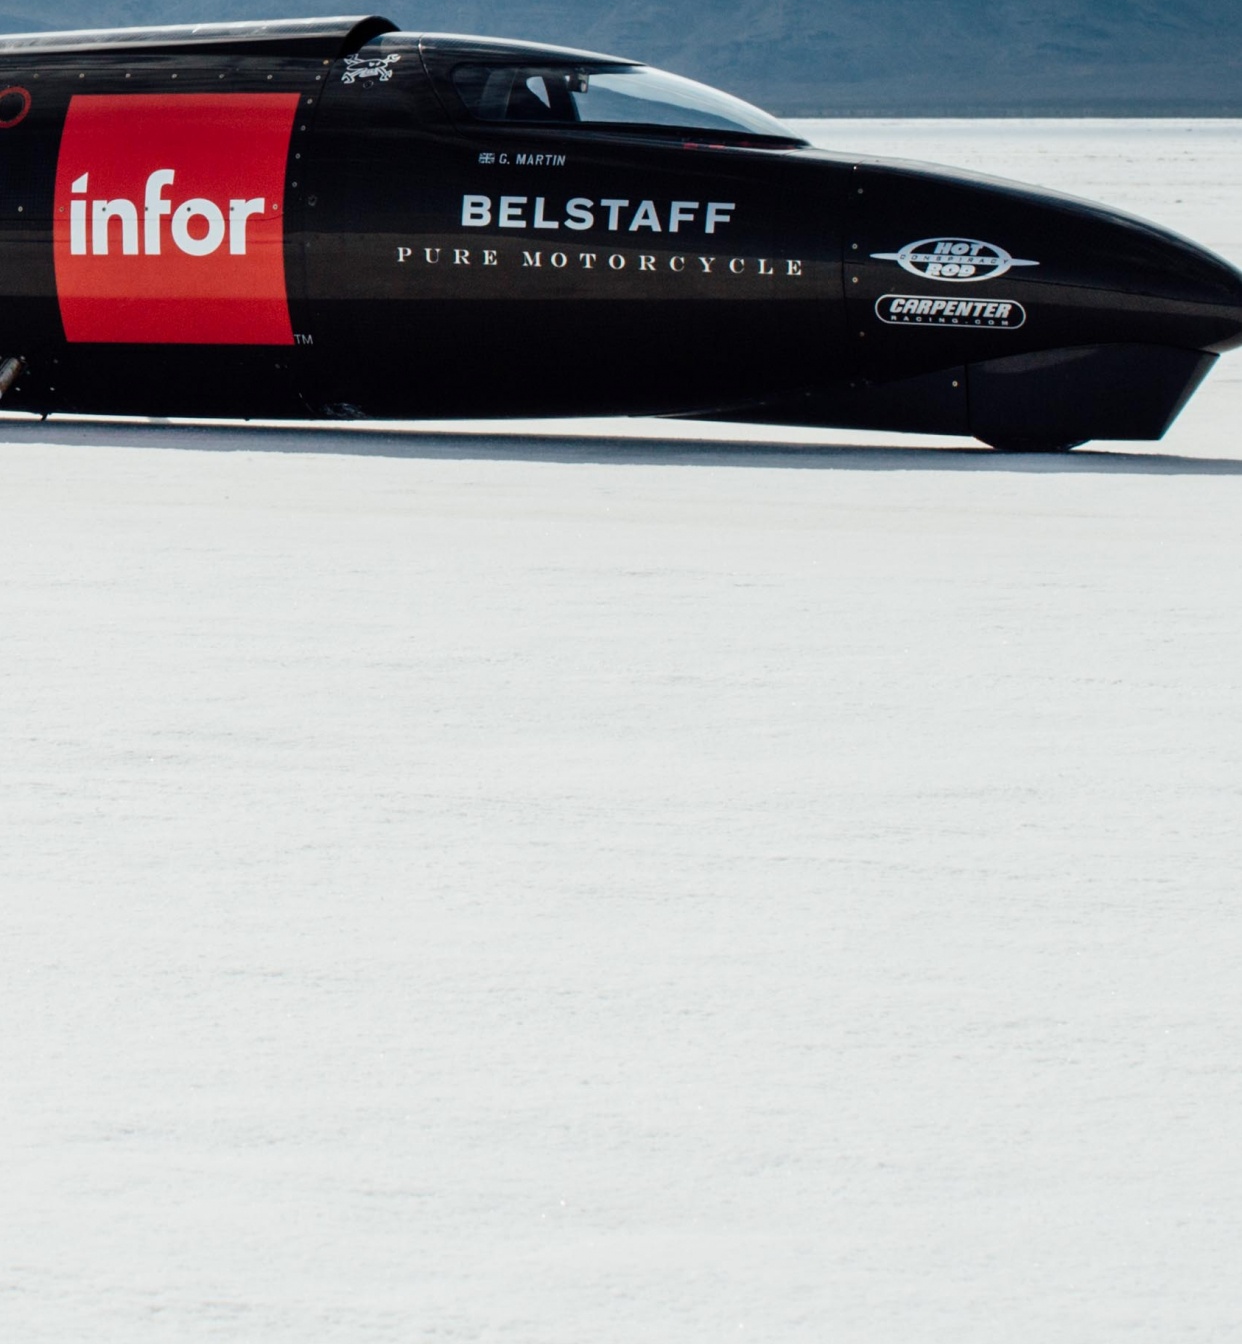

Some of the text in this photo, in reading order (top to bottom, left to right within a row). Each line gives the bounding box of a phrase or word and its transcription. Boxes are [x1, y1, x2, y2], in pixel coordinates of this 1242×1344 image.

[499, 153, 566, 166] G. MARTIN
[70, 169, 265, 256] infor
[461, 194, 736, 234] BELSTAFF
[933, 242, 984, 256] HOT
[397, 246, 802, 276] PURE MOTORCYCLE
[899, 254, 1009, 264] CONSPIRACY
[924, 263, 976, 278] ROD
[889, 298, 1013, 319] CARPENTER
[890, 315, 1009, 326] RACING.COM
[293, 334, 314, 345] TM
